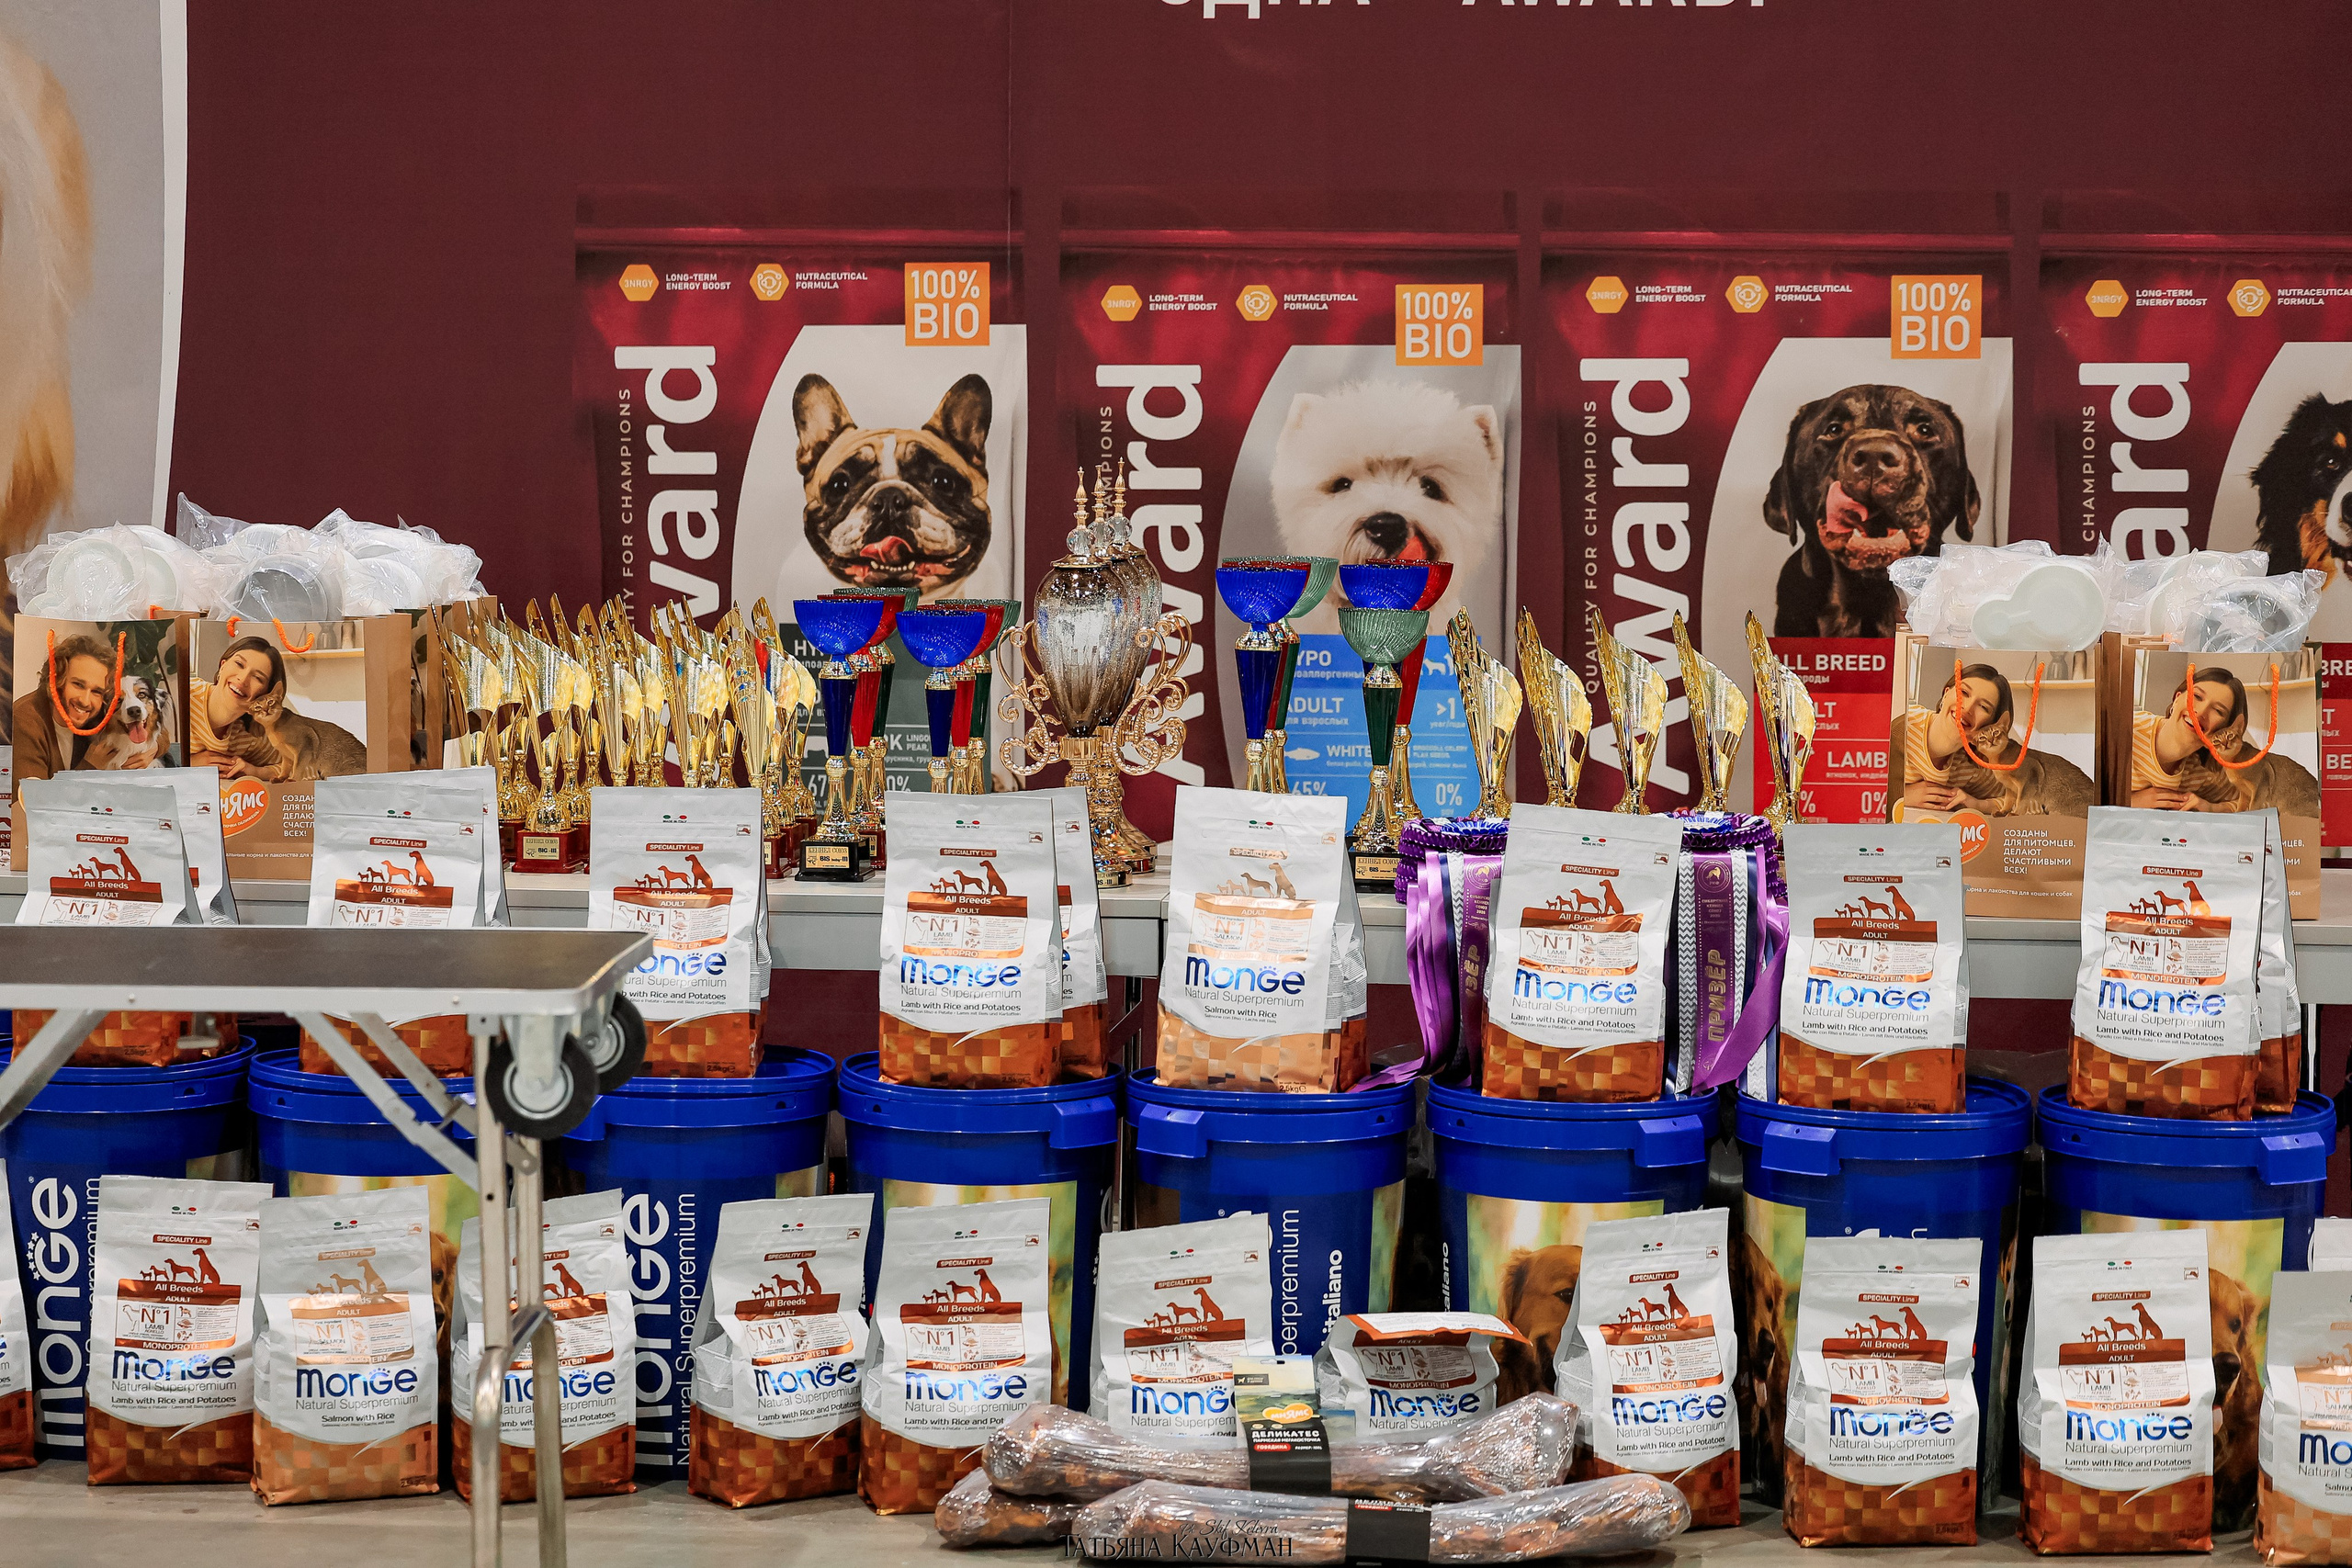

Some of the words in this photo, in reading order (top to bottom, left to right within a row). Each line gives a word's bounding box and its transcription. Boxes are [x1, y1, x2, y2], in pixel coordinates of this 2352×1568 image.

[665, 273, 718, 282] LONG-TERM
[795, 272, 868, 281] NUTRACEUTICAL
[665, 281, 701, 290] ENERGY
[702, 281, 731, 290] BOOST
[795, 280, 840, 289] FORMULA
[910, 269, 980, 299] 100%
[1635, 285, 1691, 294] LONG-TERM
[1774, 284, 1852, 293] NUTRACEUTICAL
[1148, 294, 1204, 302] LONG-TERM
[1283, 293, 1358, 302] NUTRACEUTICAL
[1635, 293, 1674, 302] ENERGY
[1675, 294, 1706, 302] BOOST
[1774, 293, 1822, 302] FORMULA
[1898, 282, 1972, 311] 100%
[2136, 289, 2193, 298] LONG-TERM
[1148, 302, 1186, 310] ENERGY
[1187, 302, 1218, 310] BOOST
[1283, 301, 1329, 310] FORMULA
[1402, 291, 1473, 321] 100%
[2136, 298, 2175, 306] ENERGY
[2176, 298, 2208, 306] BOOST
[913, 302, 980, 339] BIO
[1901, 315, 1971, 352] BIO
[1404, 322, 1472, 359] BIO
[619, 389, 634, 525] CHAMPIONS
[1583, 400, 1597, 536] CHAMPIONS
[2082, 405, 2096, 542] CHAMPIONS
[622, 534, 634, 577] FOR
[1585, 547, 1598, 590] FOR
[1296, 649, 1332, 667] YPO
[1815, 654, 1886, 671] BREED
[1827, 751, 1887, 769] LAMB
[1435, 783, 1463, 806] 0%
[283, 812, 314, 820] ДЕЛАЮ
[2003, 829, 2048, 838] СОЗДАНЫ
[2024, 840, 2076, 848] ПИТОМЦЕВ,
[2003, 848, 2042, 856] ДЕЛАЮТ
[2003, 857, 2072, 865] СЧАСТЛИВЫМИ
[2004, 866, 2028, 874] ВСЕХ!
[97, 882, 129, 890] Breeds
[371, 885, 383, 893] All
[385, 886, 418, 896] Breeds
[1866, 921, 1899, 930] Breeds
[648, 976, 727, 988] Superpremium
[688, 992, 727, 1000] Potatoes
[900, 985, 938, 998] Natural
[941, 987, 1022, 1000] Superpremium
[1185, 987, 1219, 1001] Natural
[1222, 992, 1305, 1009] Superpremium
[1707, 949, 1726, 1042] ПРИЗЁР
[1512, 997, 1552, 1011] Natural
[1555, 1002, 1637, 1017] Superpremium
[1803, 1005, 1843, 1018] Natural
[1847, 1008, 1929, 1022] Superpremium
[2097, 1009, 2138, 1023] Natural
[2141, 1013, 2225, 1029] Superpremium
[674, 1194, 700, 1371] Superpremium
[1277, 1210, 1302, 1355] perpremium
[1644, 1334, 1668, 1342] ADULT
[2097, 1343, 2109, 1351] All
[2112, 1342, 2146, 1351] Breeds
[111, 1381, 151, 1392] Natural
[153, 1381, 236, 1393] Superpremium
[295, 1398, 336, 1410] Natural
[339, 1394, 419, 1410] Superpremium
[905, 1402, 944, 1412] Natural
[948, 1402, 1028, 1414] Superpremium
[1131, 1416, 1171, 1427] Natural
[1369, 1418, 1408, 1428] Natural
[1252, 1430, 1319, 1438] ДЕЛИКАТЕС
[1616, 1427, 1651, 1438] Natural
[1654, 1421, 1726, 1437] Superpremium
[1829, 1438, 1870, 1449] Natural
[1873, 1437, 1955, 1450] Superpremium
[2065, 1441, 2108, 1454] Natural
[2110, 1442, 2192, 1456] Superpremium
